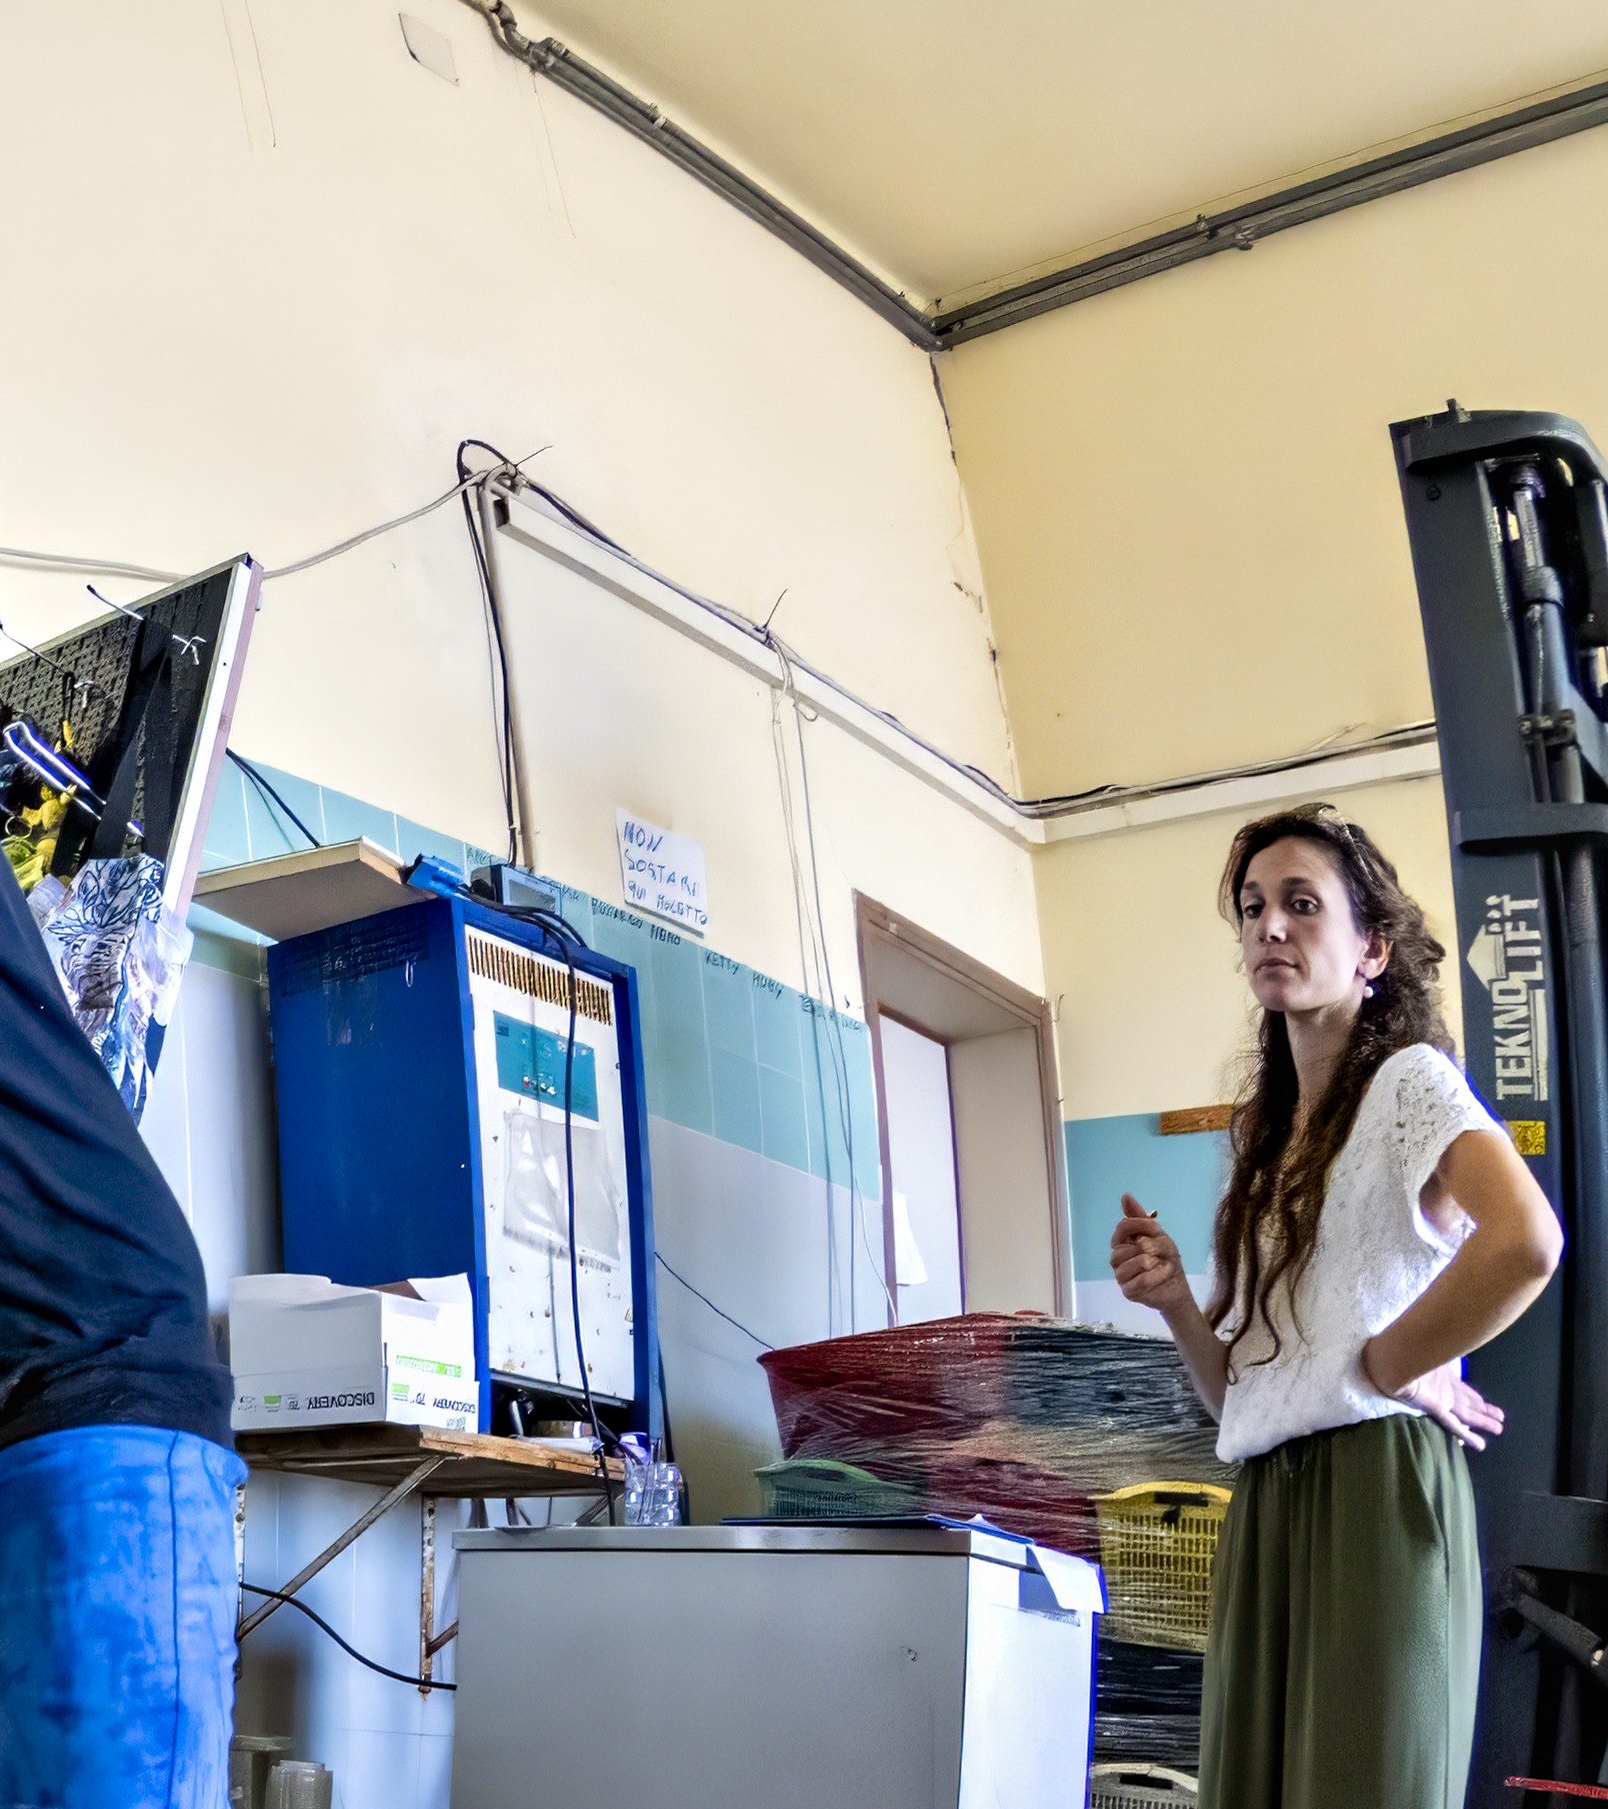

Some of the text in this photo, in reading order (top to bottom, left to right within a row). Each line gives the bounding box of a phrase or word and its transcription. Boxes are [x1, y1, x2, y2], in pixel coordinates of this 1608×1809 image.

[623, 821, 663, 852] NON
[1491, 895, 1543, 1100] TEKNOLIFT
[308, 1392, 375, 1409] DISCOVERY
